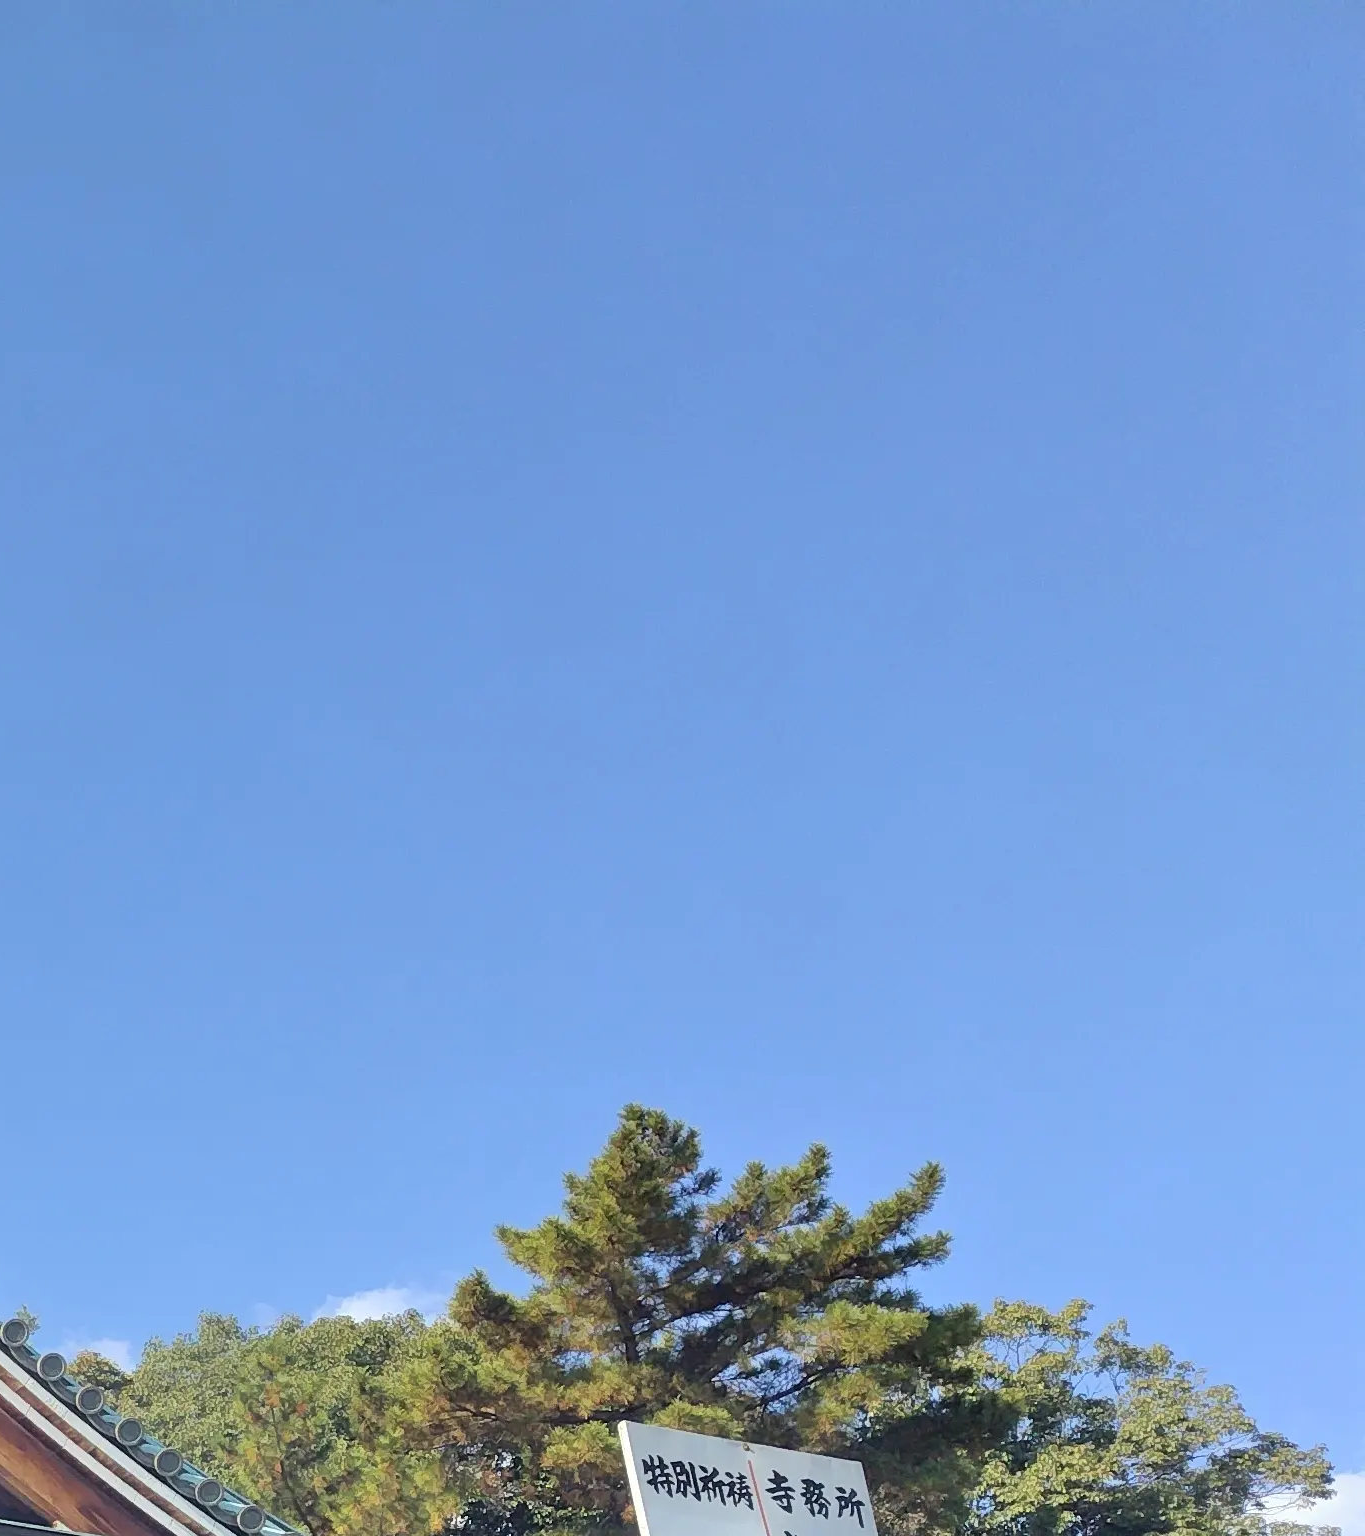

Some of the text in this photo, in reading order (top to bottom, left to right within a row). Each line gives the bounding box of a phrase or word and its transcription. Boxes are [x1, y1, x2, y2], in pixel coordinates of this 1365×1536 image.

[641, 1454, 754, 1511] 特別祈祷
[765, 1470, 866, 1529] 寺務所
